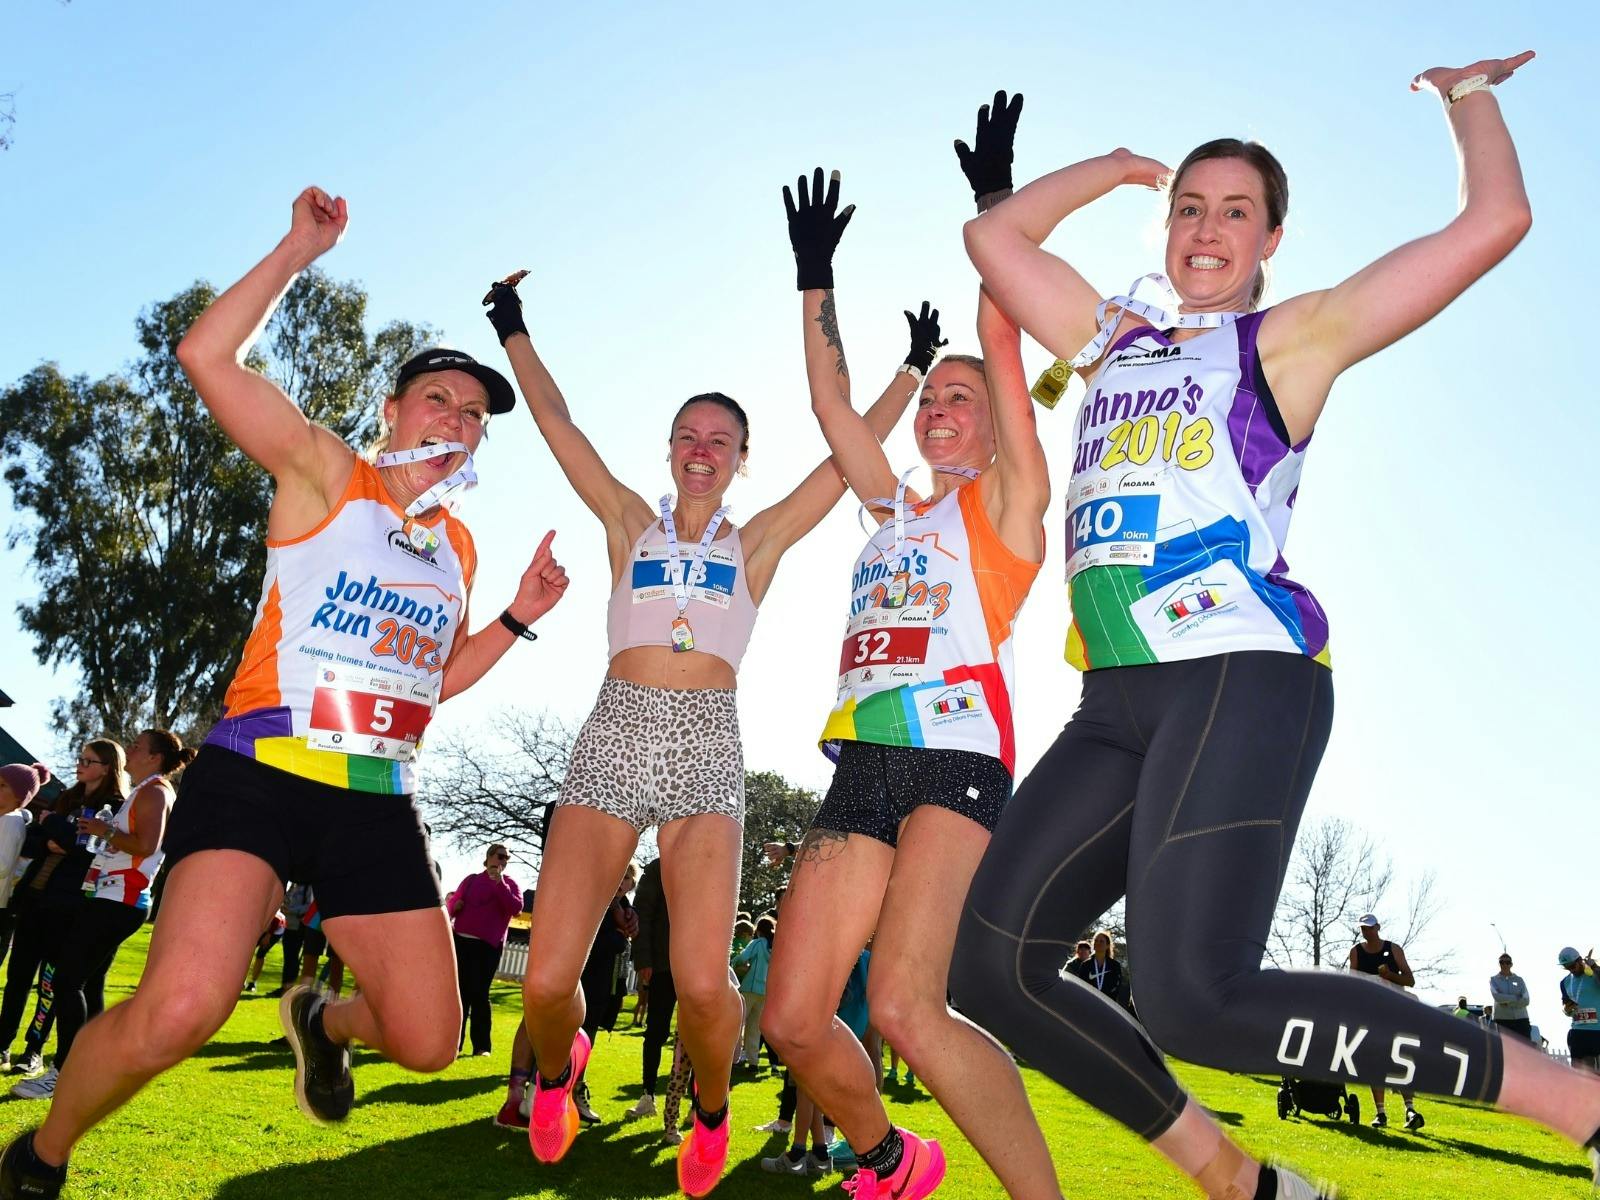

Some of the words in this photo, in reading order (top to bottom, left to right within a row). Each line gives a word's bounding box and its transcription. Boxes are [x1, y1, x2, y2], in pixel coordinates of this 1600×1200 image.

[1099, 411, 1214, 472] 2018
[1071, 500, 1123, 549] 140
[1122, 531, 1149, 540] 10km
[325, 570, 449, 634] Johnno's
[713, 584, 729, 593] 10km
[869, 580, 952, 620] 223
[310, 602, 372, 638] Run
[299, 645, 334, 660] Building
[335, 652, 364, 667] homes
[365, 659, 377, 670] for
[854, 631, 891, 663] 32
[370, 698, 394, 732] 5
